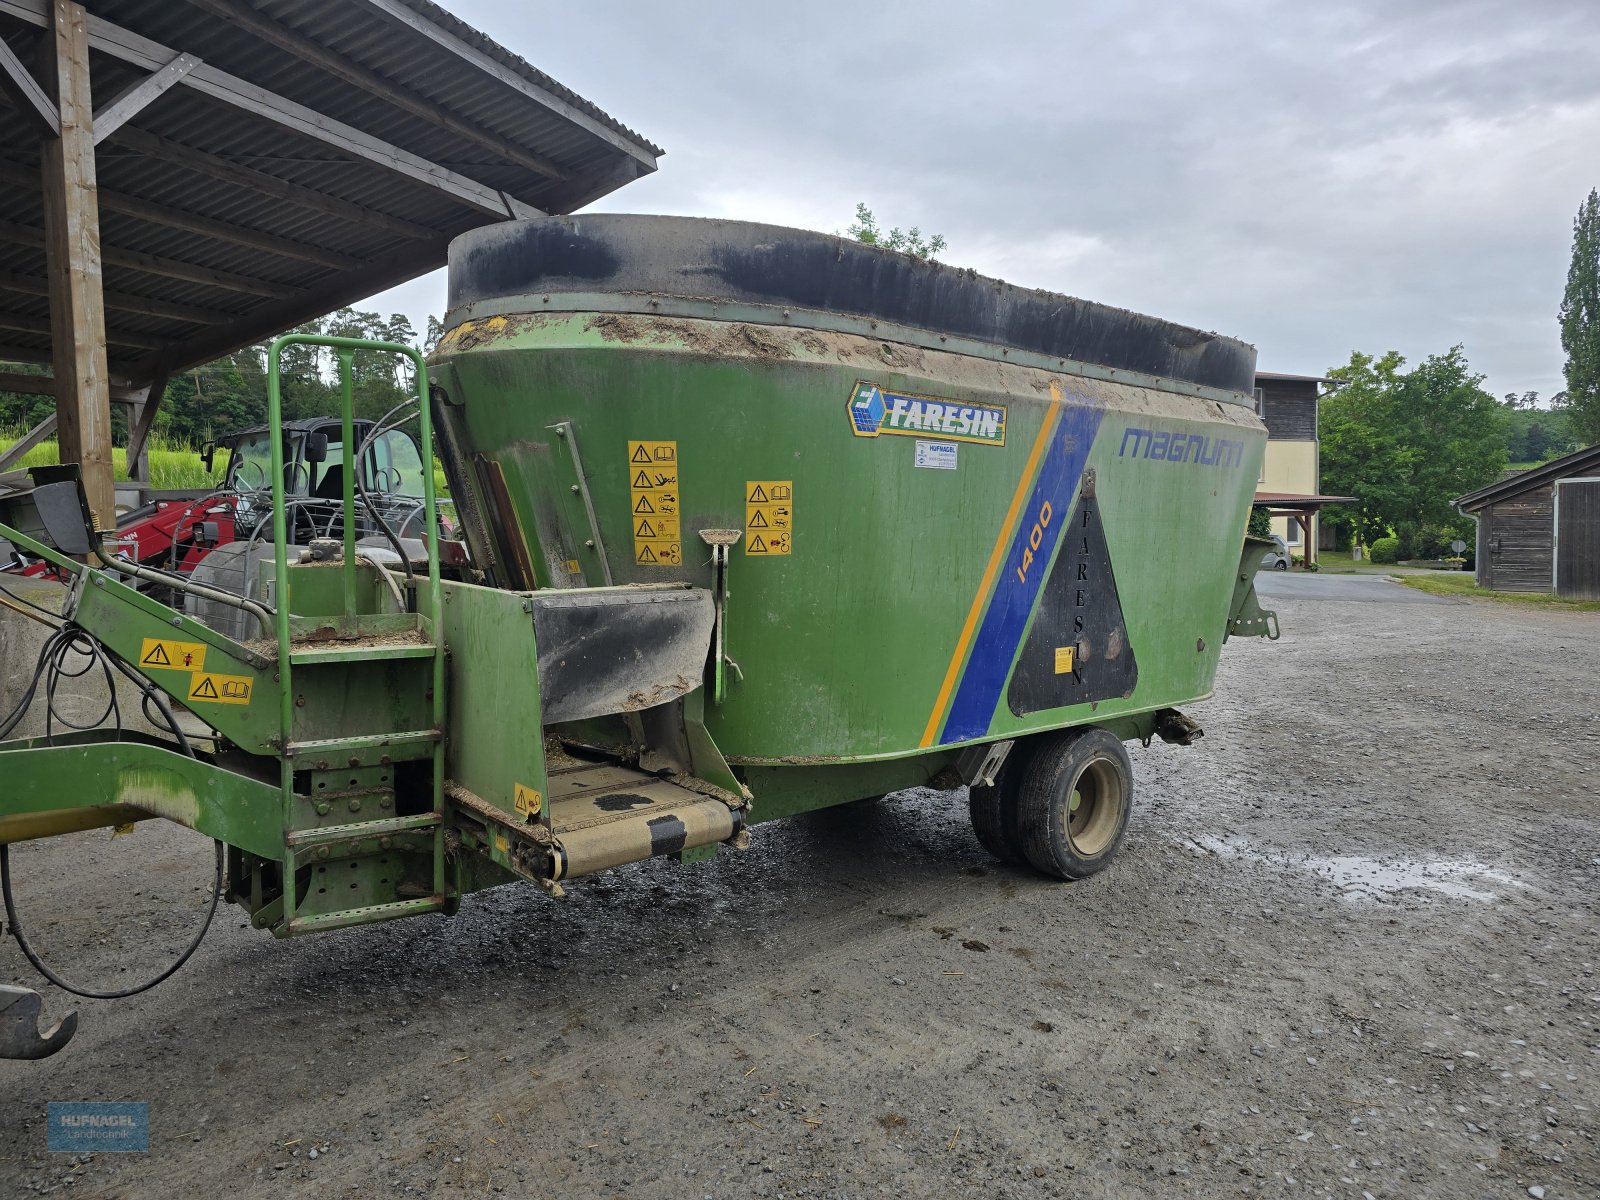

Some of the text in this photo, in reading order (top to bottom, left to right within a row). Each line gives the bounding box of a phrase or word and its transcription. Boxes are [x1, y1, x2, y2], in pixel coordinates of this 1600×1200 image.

[890, 399, 1000, 437] FARESIN
[1016, 500, 1053, 584] 1400
[1071, 510, 1092, 686] FARESIN
